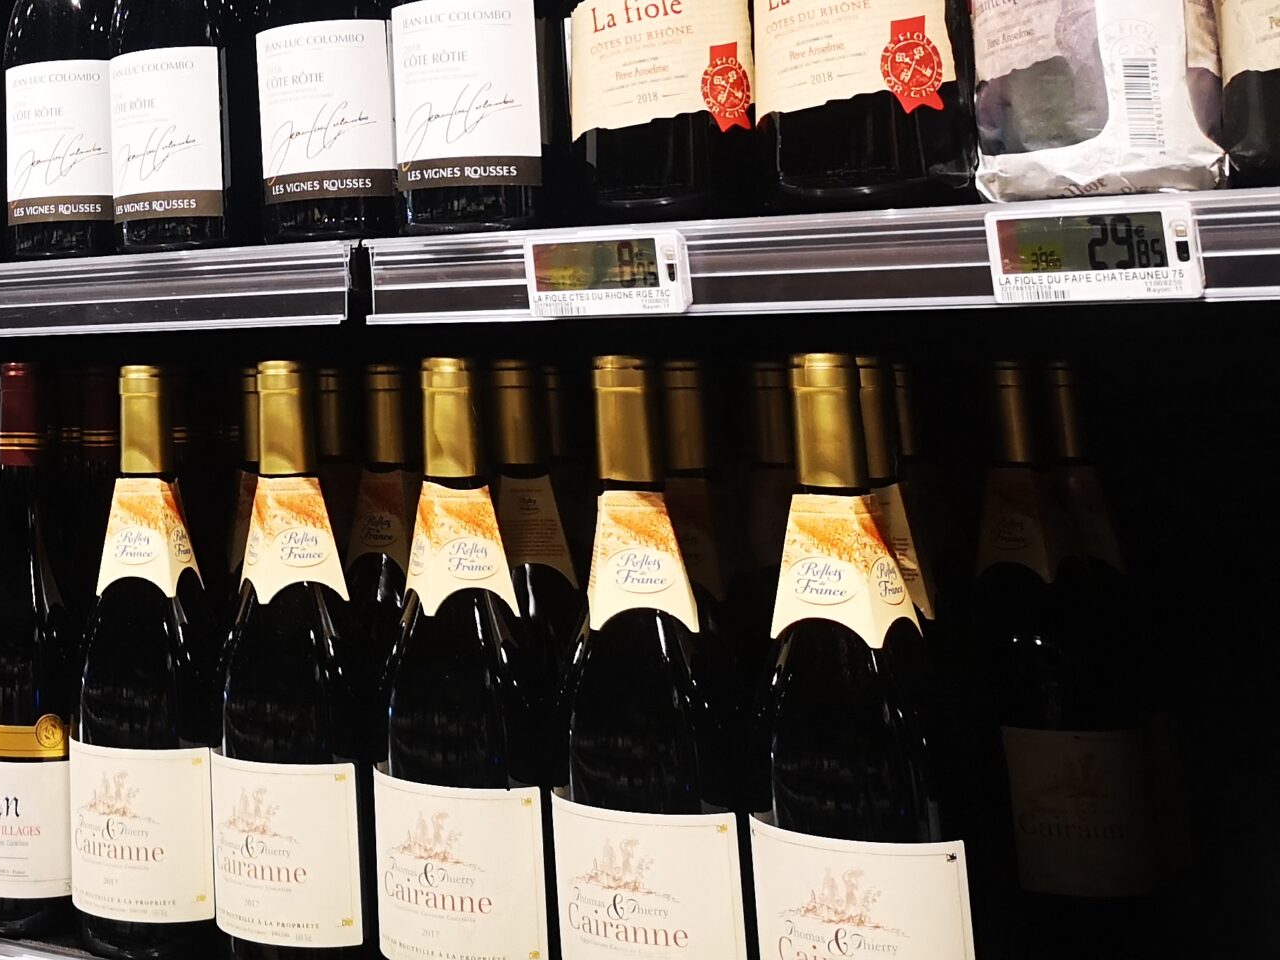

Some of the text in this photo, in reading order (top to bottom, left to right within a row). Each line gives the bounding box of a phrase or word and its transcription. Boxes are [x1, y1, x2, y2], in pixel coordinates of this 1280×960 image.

[448, 9, 512, 22] COLOMBO
[591, 7, 617, 34] La
[797, 10, 817, 23] DU
[306, 32, 365, 46] COLOMBO
[624, 33, 643, 46] DU
[646, 25, 694, 42] RHÔNE
[141, 60, 195, 74] COLOMBO
[403, 49, 469, 69] CÔTE RÔTIE
[48, 72, 101, 83] COLOMBO
[291, 71, 325, 86] RÔTIE
[810, 71, 834, 86] 2018
[129, 98, 157, 111] RÔTIE
[636, 91, 659, 105] 2018
[34, 106, 64, 119] RÔTIE
[407, 165, 518, 181] LES VIGNES ROUSSES
[272, 178, 372, 196] LES VIGNES ROUSSES
[13, 202, 102, 218] LES VIGNES ROUSSES
[125, 201, 150, 214] VIGNES
[152, 198, 197, 212] ROUSSES
[998, 269, 1184, 286] LA FIOLE DU PAPE CHATEAUNEU 75
[532, 294, 543, 304] LA
[545, 292, 567, 303] FIOLE
[592, 291, 603, 301] DU
[605, 290, 634, 300] RHONE
[636, 289, 654, 299] RGE
[120, 529, 151, 547] Reflets
[281, 530, 319, 548] Reflets
[115, 544, 154, 558] France
[280, 545, 324, 561] France
[449, 541, 488, 558] Reflets
[448, 556, 494, 573] France
[616, 553, 662, 574] Reflets
[615, 568, 668, 586] France
[798, 561, 845, 584] Reflets
[795, 577, 847, 598] France
[74, 827, 165, 864] Cairanne
[216, 845, 308, 885] Cairanne
[436, 867, 476, 888] Thierry
[384, 870, 493, 915] Cairanne
[626, 897, 670, 919] Thierry
[568, 901, 689, 949] Cairanne
[785, 920, 827, 945] Thomas
[850, 932, 899, 956] Thierry
